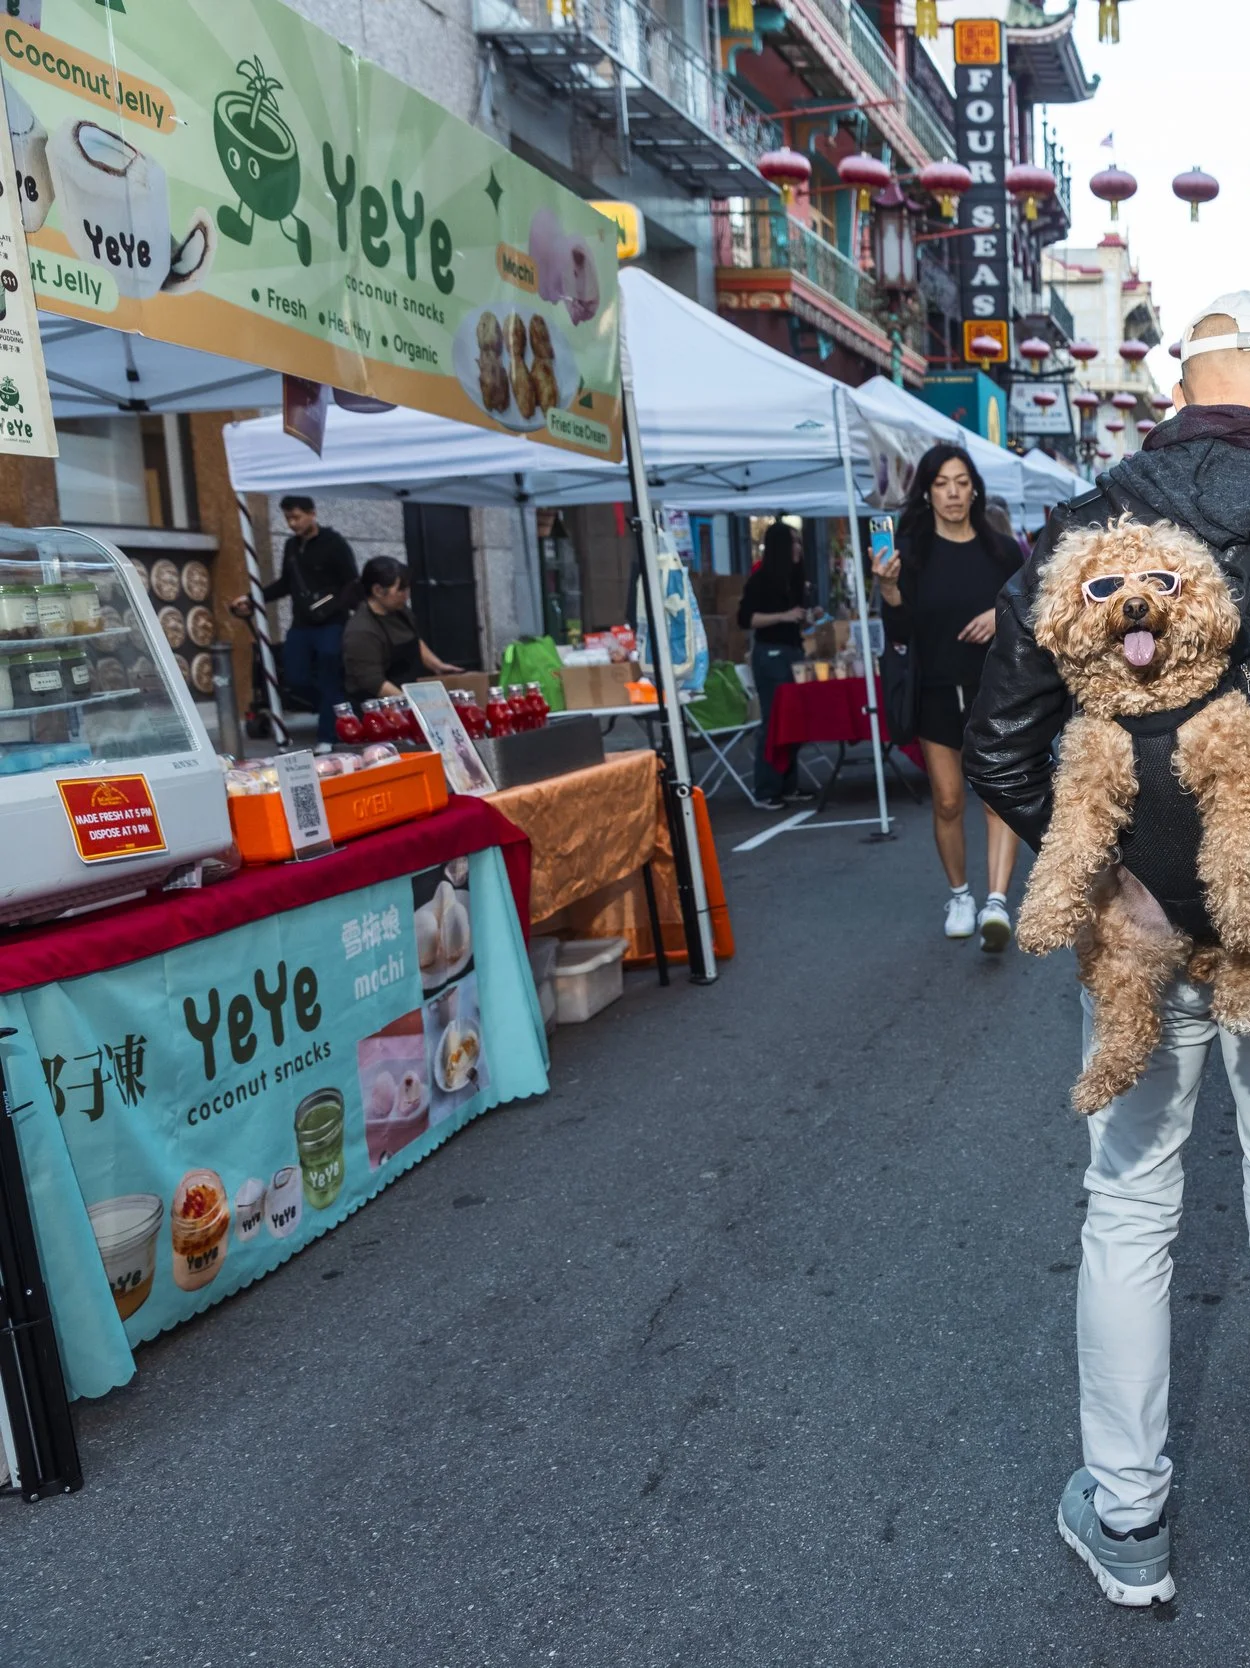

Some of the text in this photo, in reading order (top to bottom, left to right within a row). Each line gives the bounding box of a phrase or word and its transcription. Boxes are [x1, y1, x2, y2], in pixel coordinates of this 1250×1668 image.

[4, 28, 164, 128] Coconut Jelly
[965, 68, 996, 184] FOUR
[322, 140, 455, 295] YeYe
[83, 218, 152, 269] YeYe
[970, 205, 1000, 317] SEAS
[3, 275, 17, 287] $11
[52, 264, 102, 305] Jelly
[503, 253, 535, 285] Mochi
[267, 287, 308, 320] Fresh
[346, 272, 446, 325] coconut snacks
[328, 310, 371, 349] Heathy
[393, 335, 439, 367] Organic
[551, 414, 573, 434] Fried
[75, 807, 153, 825] MADE FRESH AT 5 PM
[88, 824, 150, 840] DISPOSE AT 9 PM
[354, 951, 404, 1000] mochi
[183, 960, 322, 1081] YeYe
[187, 1041, 331, 1126] coconut snacks
[309, 1162, 339, 1188] YeYe
[242, 1212, 261, 1233] YeYe
[271, 1205, 297, 1230] YeYe
[186, 1246, 219, 1270] YeYe
